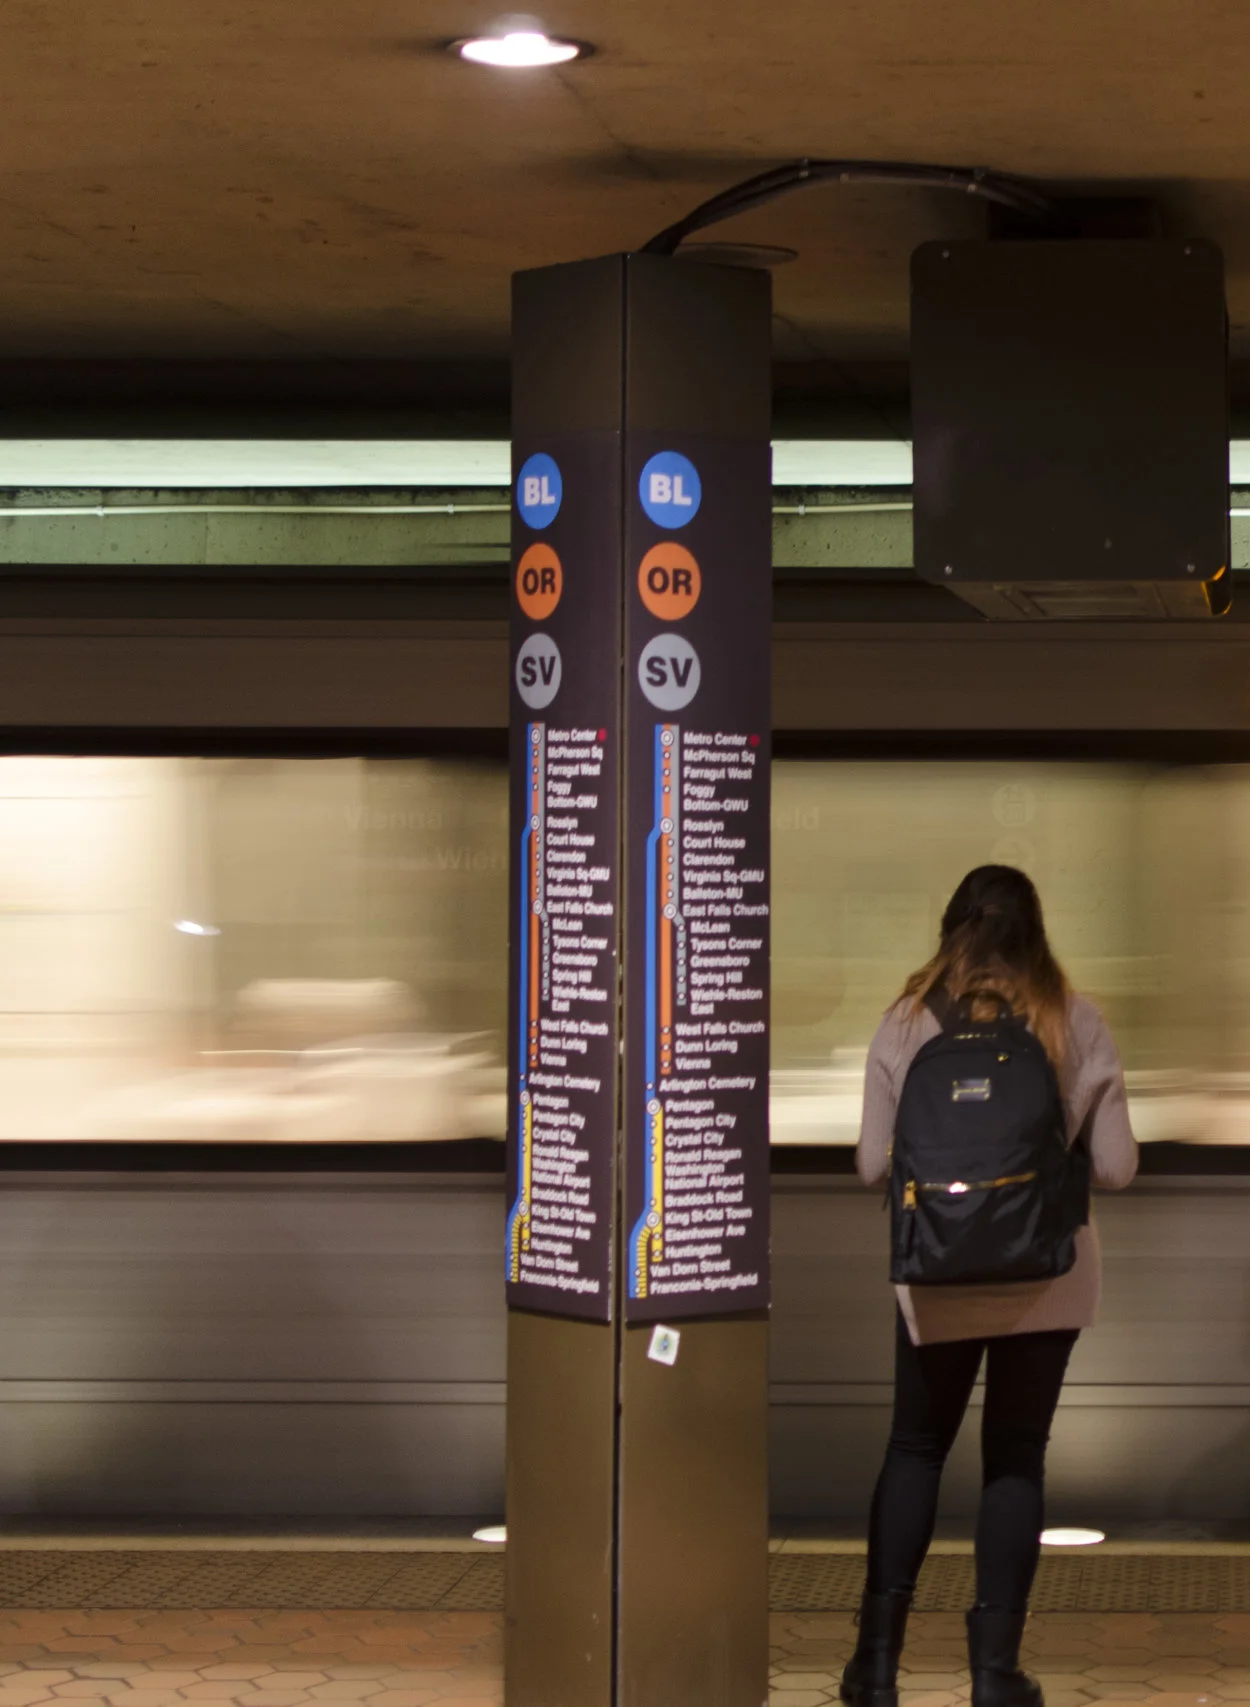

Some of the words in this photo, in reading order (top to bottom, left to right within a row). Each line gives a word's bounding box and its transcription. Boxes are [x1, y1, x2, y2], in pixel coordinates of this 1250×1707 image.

[524, 476, 555, 506] BL
[650, 474, 692, 506] BL
[523, 568, 555, 595] OR
[647, 567, 692, 596] OR
[521, 657, 556, 687] SV
[646, 657, 693, 687] SV
[548, 730, 570, 742] Metro
[570, 728, 596, 742] Center
[684, 732, 714, 744] Metro
[714, 733, 747, 746] Center
[548, 746, 590, 758] McPherson
[684, 749, 740, 762] McPherson
[740, 750, 756, 764] Sq
[548, 762, 580, 778] Farragut
[580, 764, 600, 776] West
[684, 766, 726, 781] Farragut
[728, 768, 752, 780] West
[548, 780, 572, 796] Foggy
[684, 783, 716, 798] Foggy
[684, 798, 748, 812] Bottom-GWU
[546, 816, 578, 831] Rosslyn
[683, 819, 724, 834] Rosslyn
[546, 832, 568, 846] Court
[569, 834, 595, 846] House
[683, 836, 712, 848] Court
[714, 836, 746, 848] House
[546, 850, 586, 864] Clarendon
[683, 853, 734, 866] Clarendon
[546, 866, 576, 882] Virginia
[682, 870, 722, 885] Virginia
[722, 870, 764, 884] Sq-GMU
[682, 887, 744, 900] Ballston-MU
[546, 900, 564, 914] East
[564, 900, 584, 914] Falls
[584, 902, 614, 916] Church
[682, 904, 706, 916] East
[708, 904, 732, 916] Falls
[733, 904, 769, 916] Church
[552, 918, 582, 932] McLean
[690, 920, 730, 934] McLean
[552, 934, 580, 950] Tysons
[580, 936, 608, 950] Corner
[690, 938, 726, 952] Tysons
[728, 937, 762, 950] Corner
[552, 952, 598, 966] Greensboro
[690, 955, 750, 968] Greensboro
[552, 968, 576, 984] Spring
[577, 970, 592, 982] Hill
[690, 972, 724, 986] Spring
[726, 972, 742, 984] Hill
[690, 988, 762, 1002] Wiehle-Reston
[552, 1000, 570, 1012] East
[690, 1002, 714, 1016] East
[540, 1018, 562, 1032] West
[562, 1020, 579, 1034] Falls
[579, 1021, 608, 1036] Church
[675, 1022, 702, 1036] West
[703, 1022, 728, 1034] Falls
[728, 1020, 764, 1034] Church
[540, 1036, 562, 1048] Dunn
[562, 1038, 588, 1054] Loring
[676, 1040, 704, 1054] Dunn
[706, 1040, 738, 1054] Loring
[540, 1052, 567, 1066] Vienna
[675, 1058, 712, 1070] Vienna
[528, 1072, 563, 1088] Arlington
[563, 1074, 600, 1092] Cemetery
[659, 1078, 706, 1094] Arlington
[708, 1076, 756, 1090] Cemetery
[532, 1092, 570, 1110] Pentagon
[665, 1098, 714, 1114] Pentagon
[532, 1110, 569, 1127] Pentagon
[569, 1112, 586, 1130] City
[665, 1116, 714, 1130] Pentagon
[715, 1114, 736, 1128] City
[532, 1126, 560, 1142] Crystal
[560, 1129, 576, 1146] City
[665, 1132, 702, 1148] Crystal
[703, 1132, 724, 1146] City
[532, 1144, 559, 1158] Ronald
[559, 1146, 590, 1164] Reagan
[665, 1150, 702, 1164] Ronald
[703, 1148, 742, 1162] Reagan
[532, 1156, 576, 1174] Washington
[665, 1162, 726, 1179] Washington
[532, 1170, 562, 1186] National
[562, 1172, 590, 1190] Airport
[665, 1176, 706, 1190] National
[708, 1172, 744, 1188] Airport
[532, 1186, 566, 1202] Braddock
[567, 1190, 590, 1206] Road
[665, 1192, 714, 1207] Braddock
[716, 1190, 743, 1204] Road
[531, 1204, 550, 1220] King
[574, 1208, 596, 1224] Town
[665, 1212, 690, 1226] King
[725, 1206, 752, 1220] Town
[530, 1220, 574, 1238] Eisenhower
[574, 1226, 590, 1240] Ave
[665, 1227, 724, 1242] Eisenhower
[726, 1224, 746, 1236] Ave
[530, 1238, 572, 1256] Huntington
[665, 1244, 722, 1260] Huntington
[520, 1252, 536, 1266] Van
[536, 1254, 555, 1268] Dorn
[555, 1258, 578, 1272] Street
[650, 1264, 671, 1278] Van
[672, 1262, 698, 1276] Dorn
[700, 1258, 730, 1274] Street
[650, 1272, 758, 1294] Franconia-Springfield
